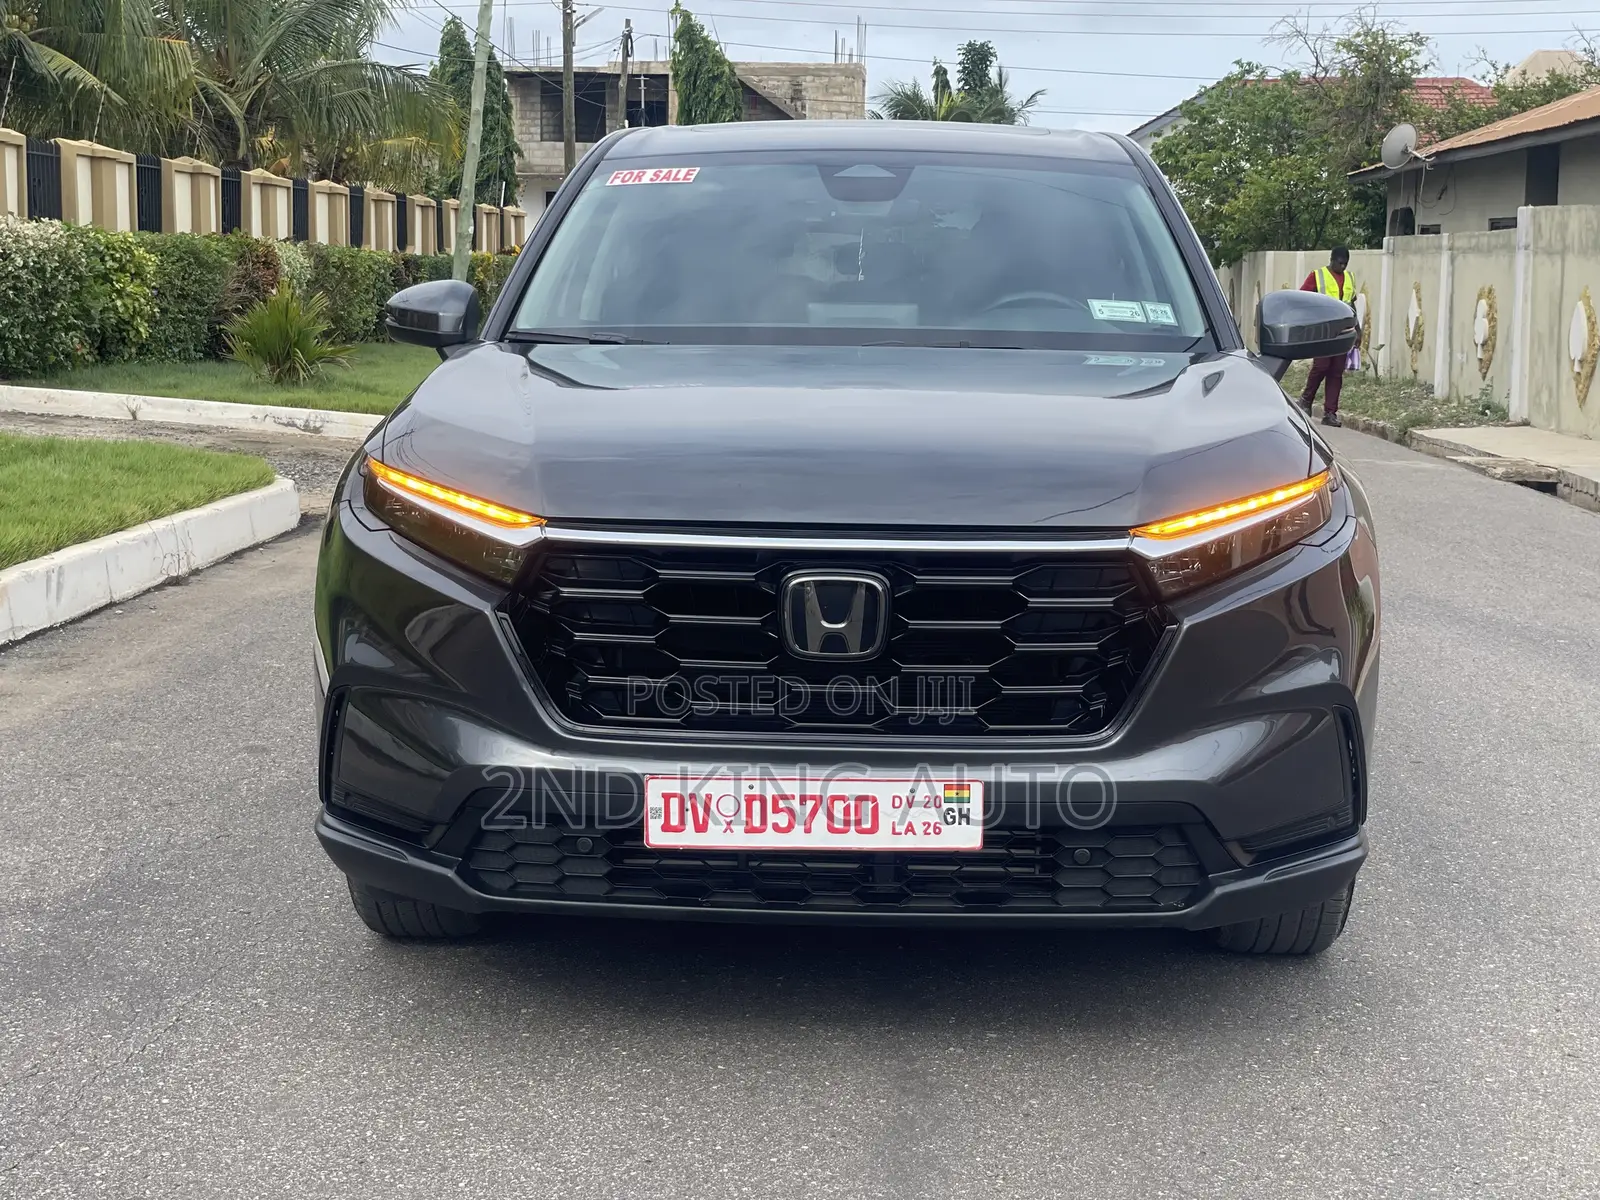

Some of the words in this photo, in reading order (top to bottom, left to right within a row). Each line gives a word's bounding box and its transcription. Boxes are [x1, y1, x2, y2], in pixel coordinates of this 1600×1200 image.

[609, 171, 647, 184] FOR
[649, 169, 697, 182] SALE
[891, 795, 915, 809] DV
[923, 795, 942, 809] 20
[660, 792, 713, 833] DV
[743, 793, 880, 835] D5700
[943, 807, 971, 826] GH
[891, 821, 917, 836] LA
[921, 821, 942, 836] 26
